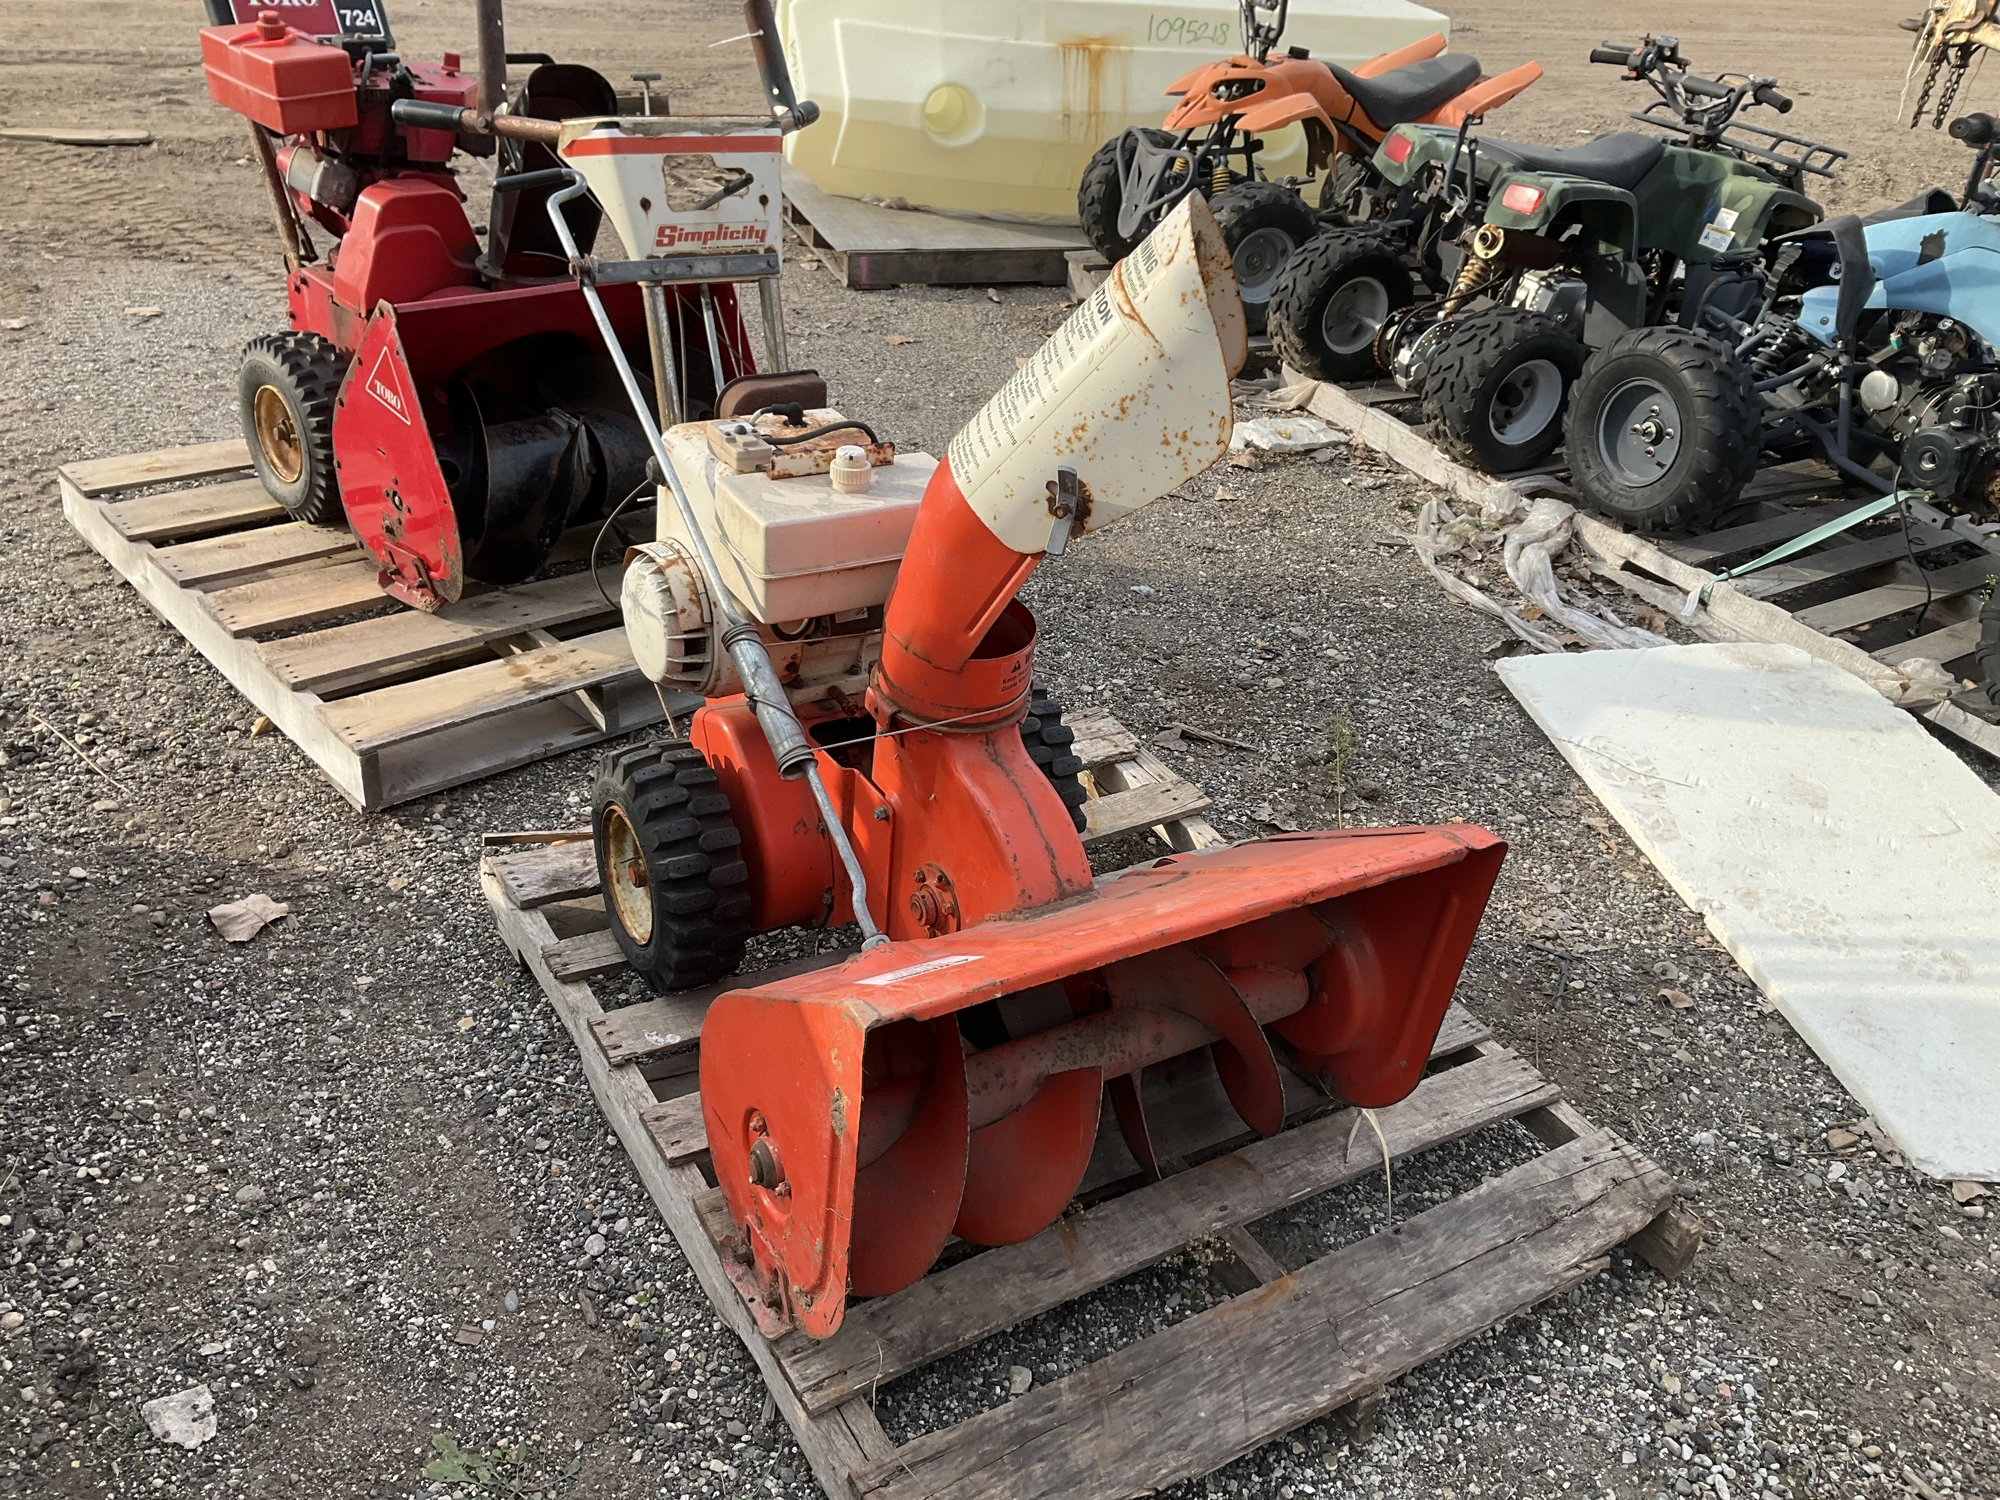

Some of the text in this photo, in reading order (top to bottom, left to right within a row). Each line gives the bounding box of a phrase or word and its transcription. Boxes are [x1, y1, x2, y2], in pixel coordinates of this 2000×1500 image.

[339, 10, 376, 26] 724
[1148, 14, 1230, 45] 1095218
[655, 224, 767, 248] Simplicity
[1125, 269, 1139, 300] Running
[374, 379, 401, 411] TORO
[1009, 394, 1021, 424] Clothing
[992, 429, 1001, 450] Face
[1001, 414, 1017, 448] Slipping
[977, 432, 990, 461] operate
